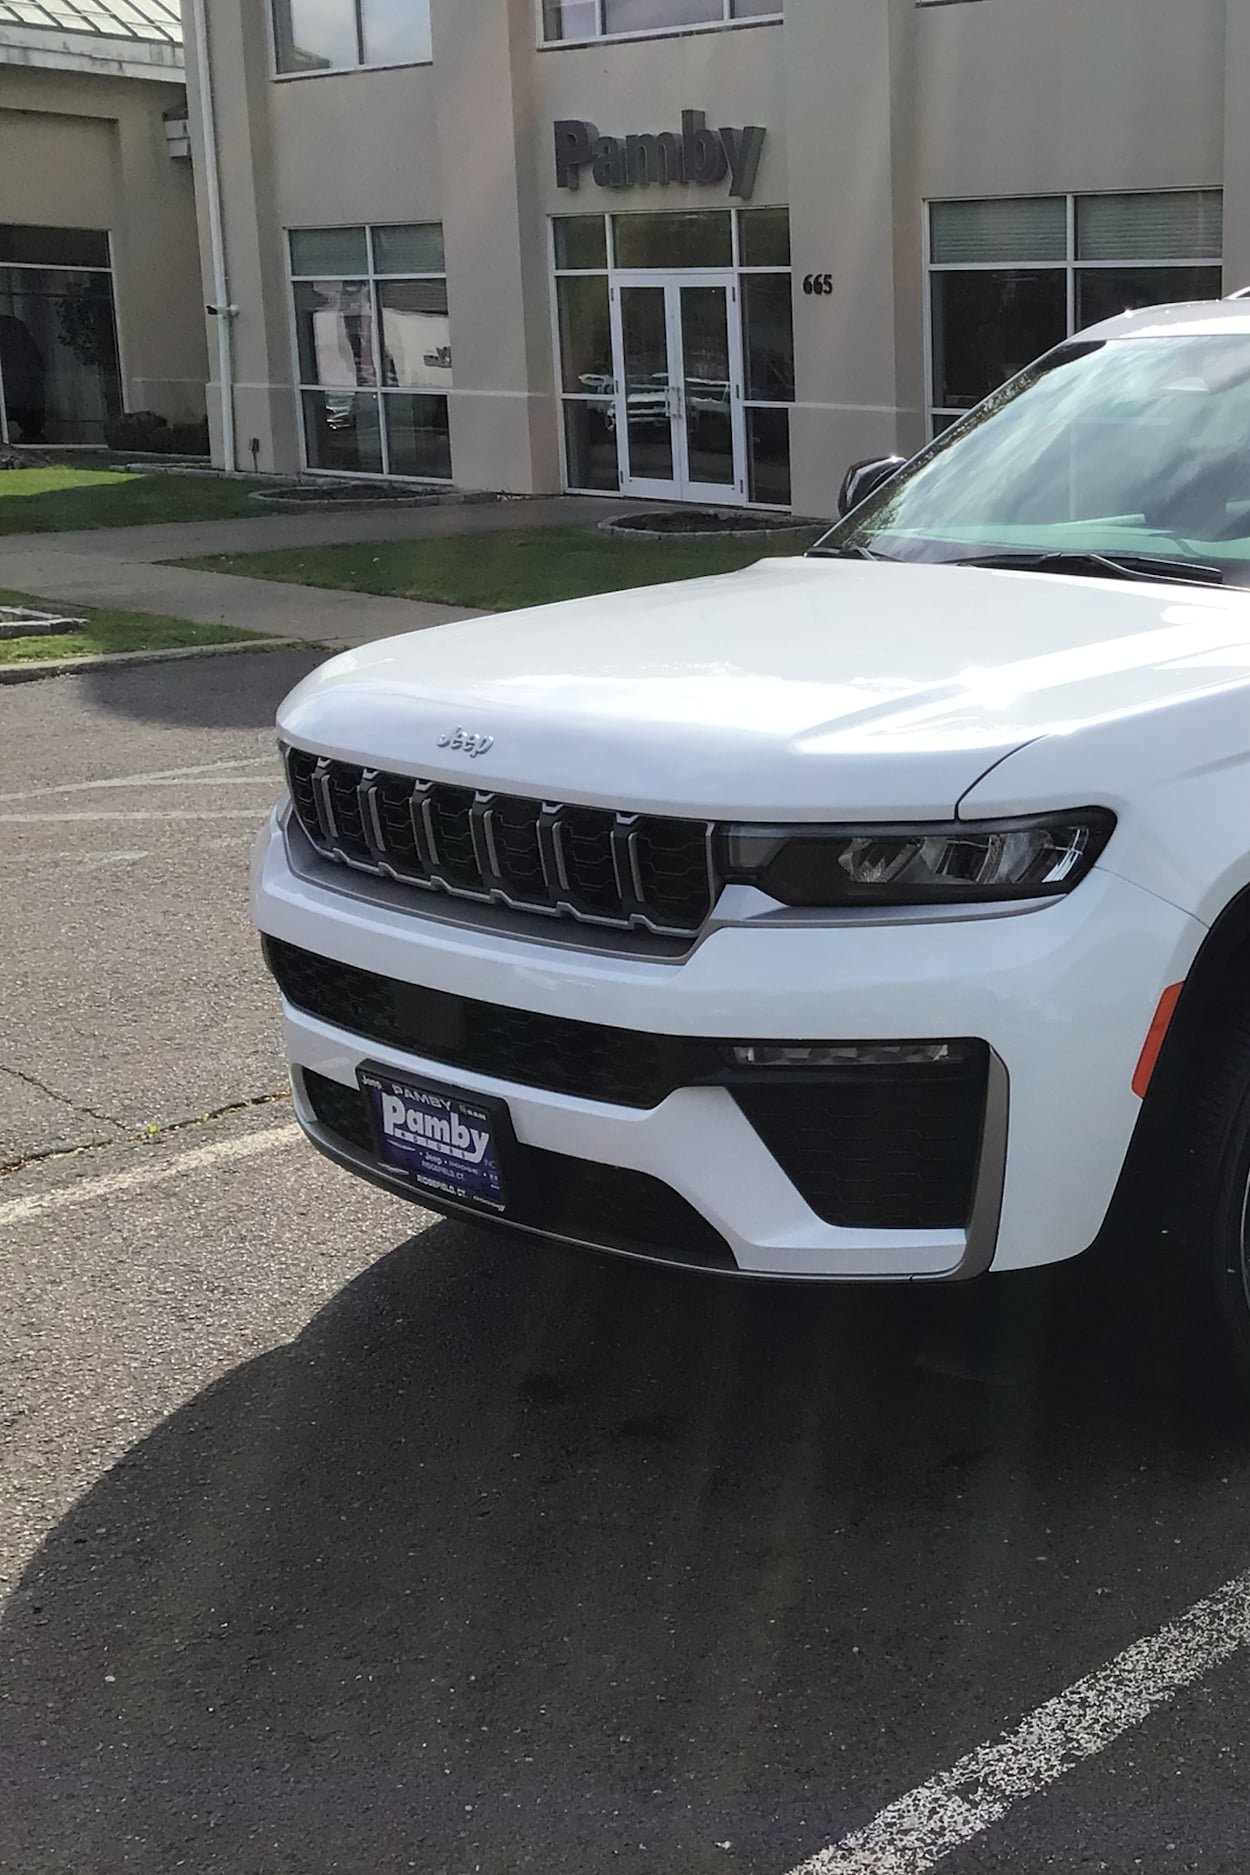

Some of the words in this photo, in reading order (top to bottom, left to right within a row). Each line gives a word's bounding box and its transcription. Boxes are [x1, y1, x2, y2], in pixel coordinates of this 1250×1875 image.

[553, 109, 767, 200] Pamby
[803, 274, 833, 295] 665
[437, 725, 494, 758] Jeep
[392, 1084, 451, 1111] PAMBY
[382, 1092, 489, 1163] Pamby
